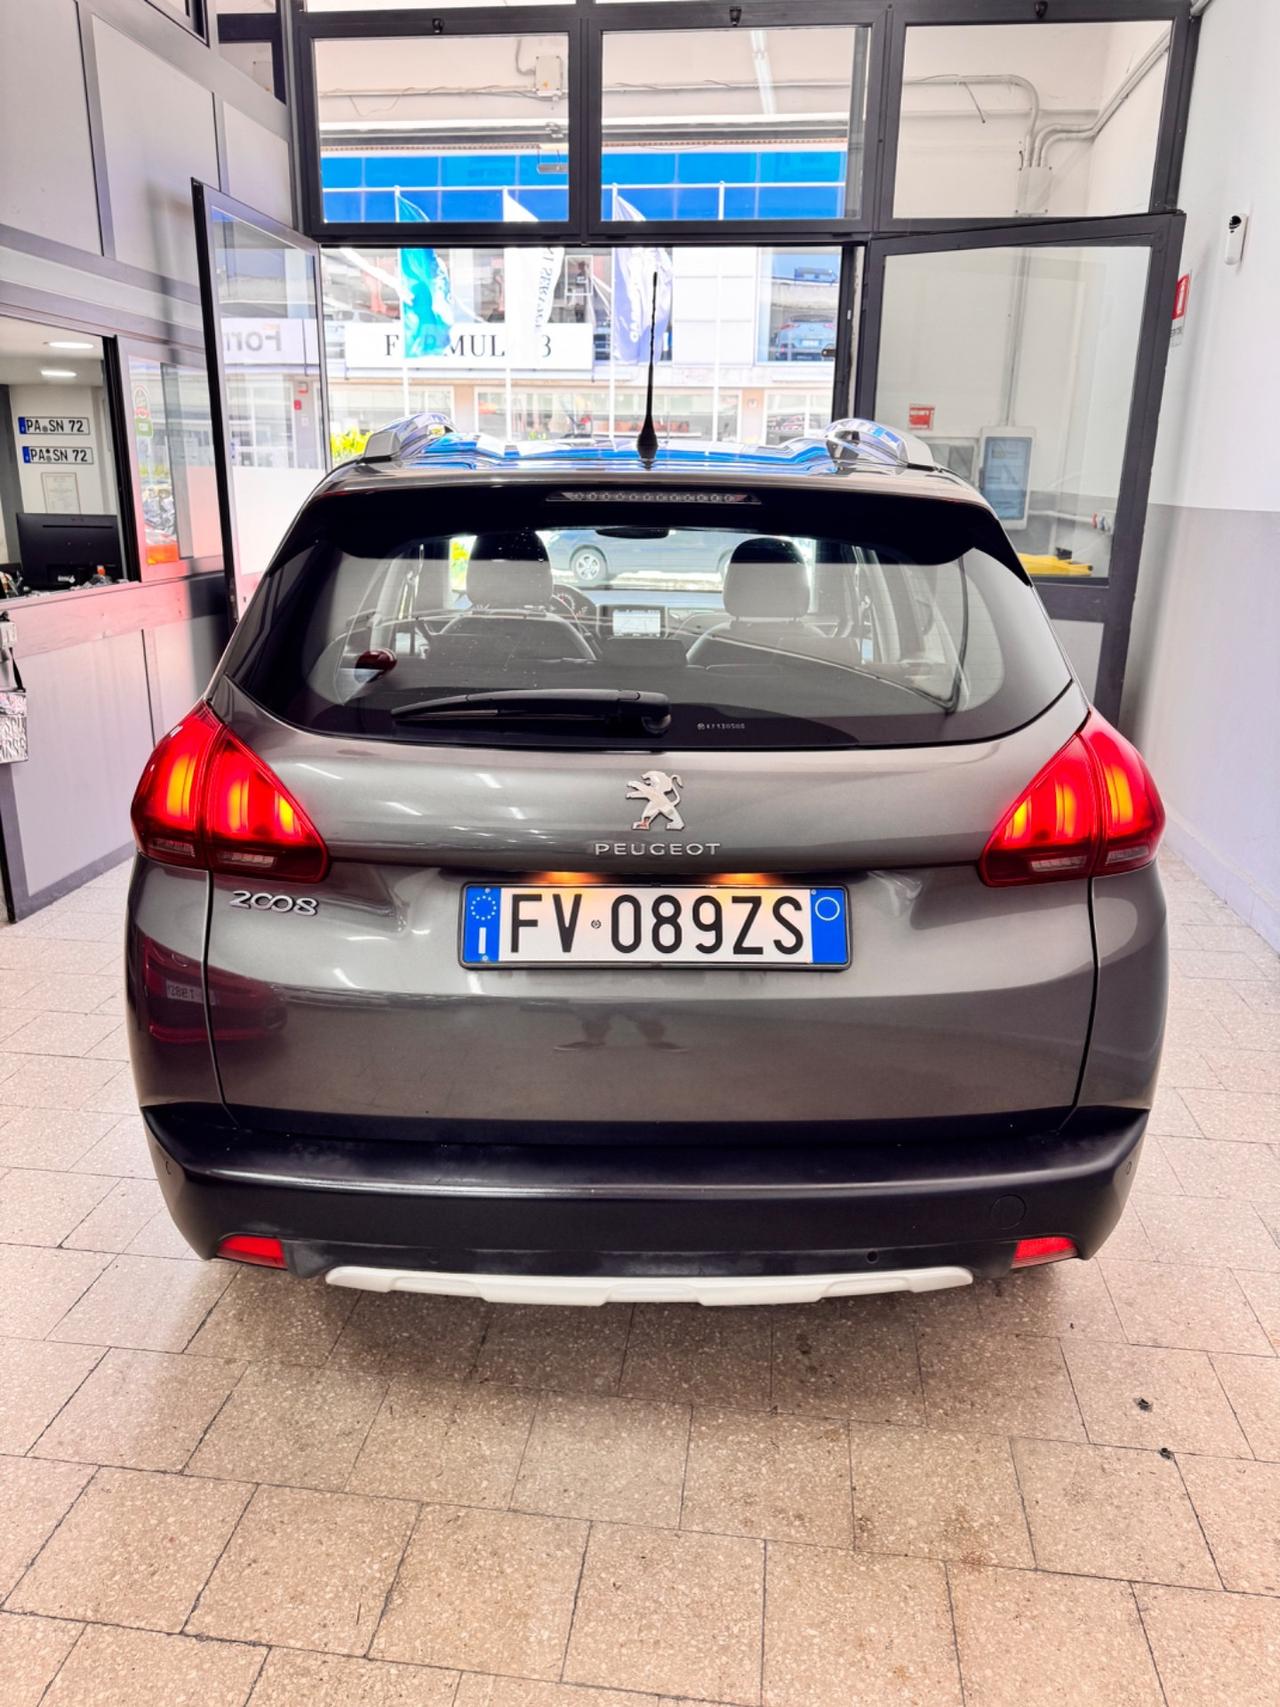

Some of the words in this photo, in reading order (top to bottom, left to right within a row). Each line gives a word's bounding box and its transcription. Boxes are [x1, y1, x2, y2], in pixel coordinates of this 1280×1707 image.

[26, 419, 41, 433] PA
[48, 419, 64, 433] SN
[68, 419, 84, 433] 72
[30, 448, 45, 461] PA
[52, 448, 68, 462] SN
[72, 449, 88, 463] 72
[594, 842, 721, 856] PEUGEOT
[229, 890, 319, 916] 2008
[510, 893, 583, 954] FV
